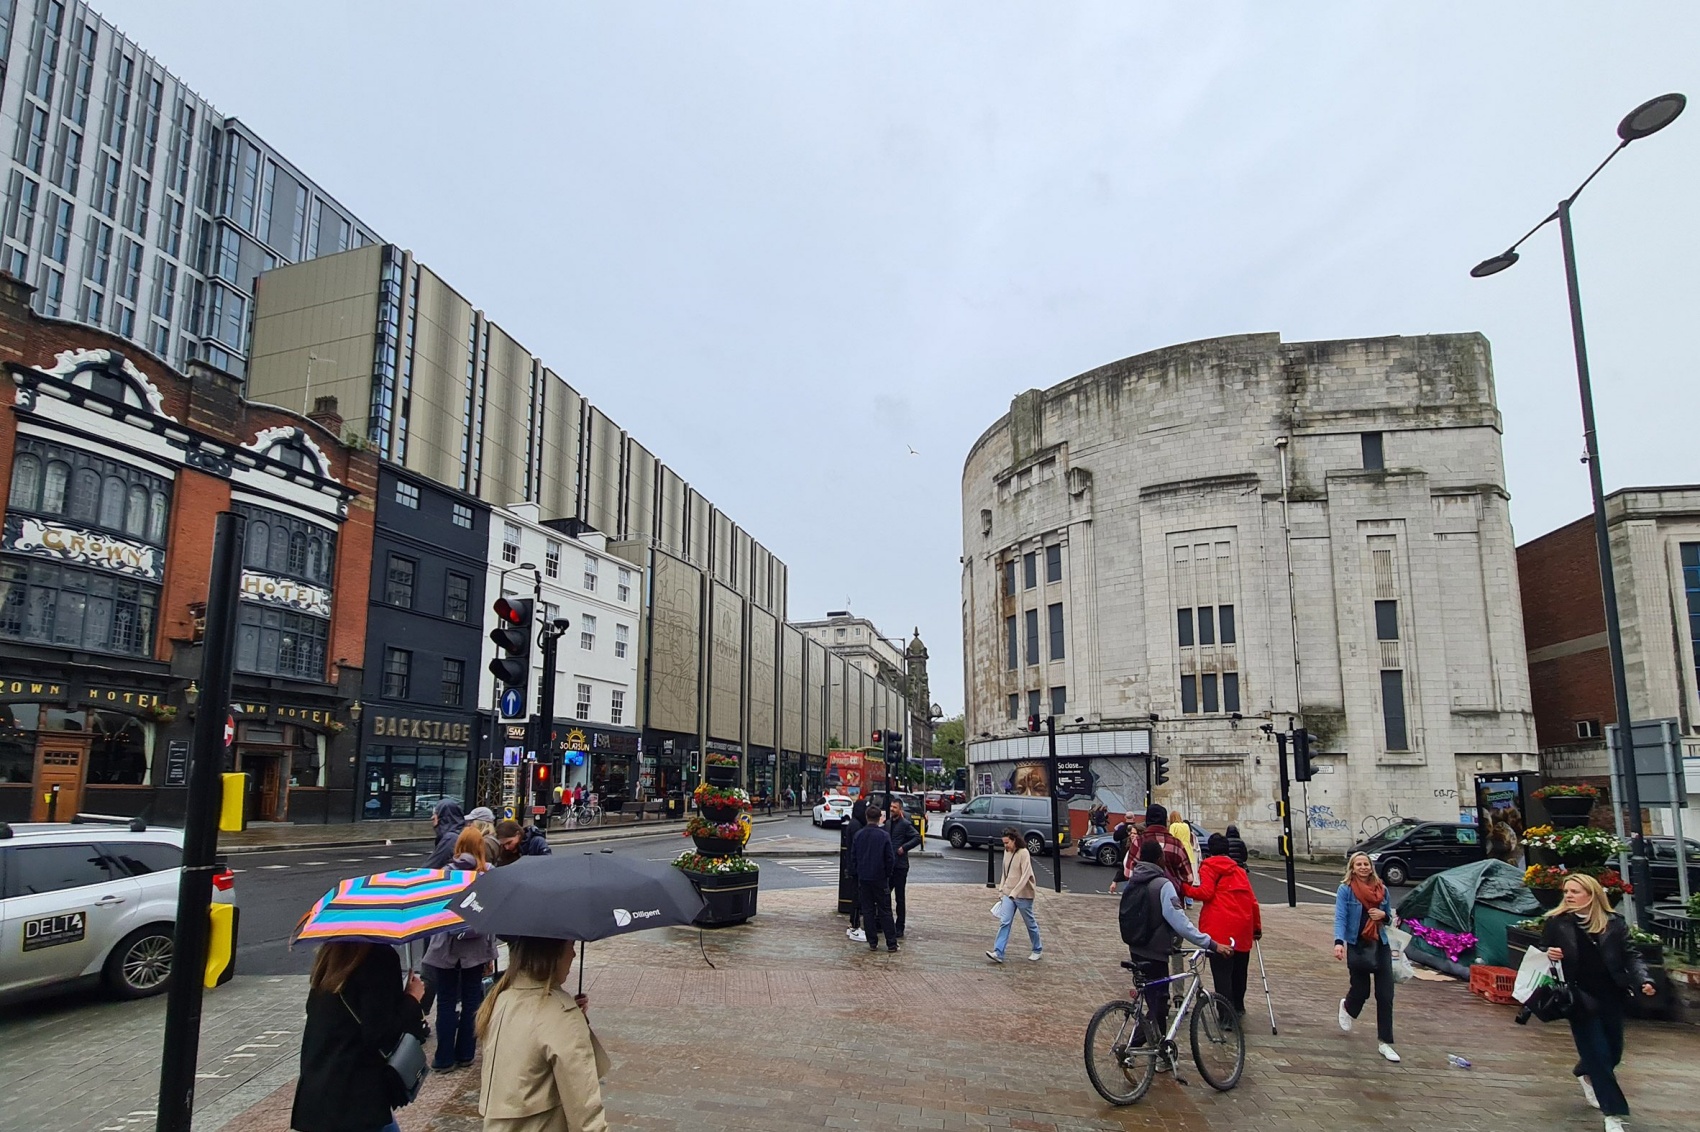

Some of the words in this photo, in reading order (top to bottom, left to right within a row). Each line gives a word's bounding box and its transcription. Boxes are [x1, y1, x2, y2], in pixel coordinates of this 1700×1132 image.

[42, 530, 141, 566] CROWN
[244, 577, 318, 606] HOTEL
[89, 688, 159, 707] HOTEL
[278, 707, 330, 725] HOTEL
[374, 716, 471, 742] BACKSTAGE
[26, 913, 83, 938] DELTA
[632, 909, 661, 919] Diligent
